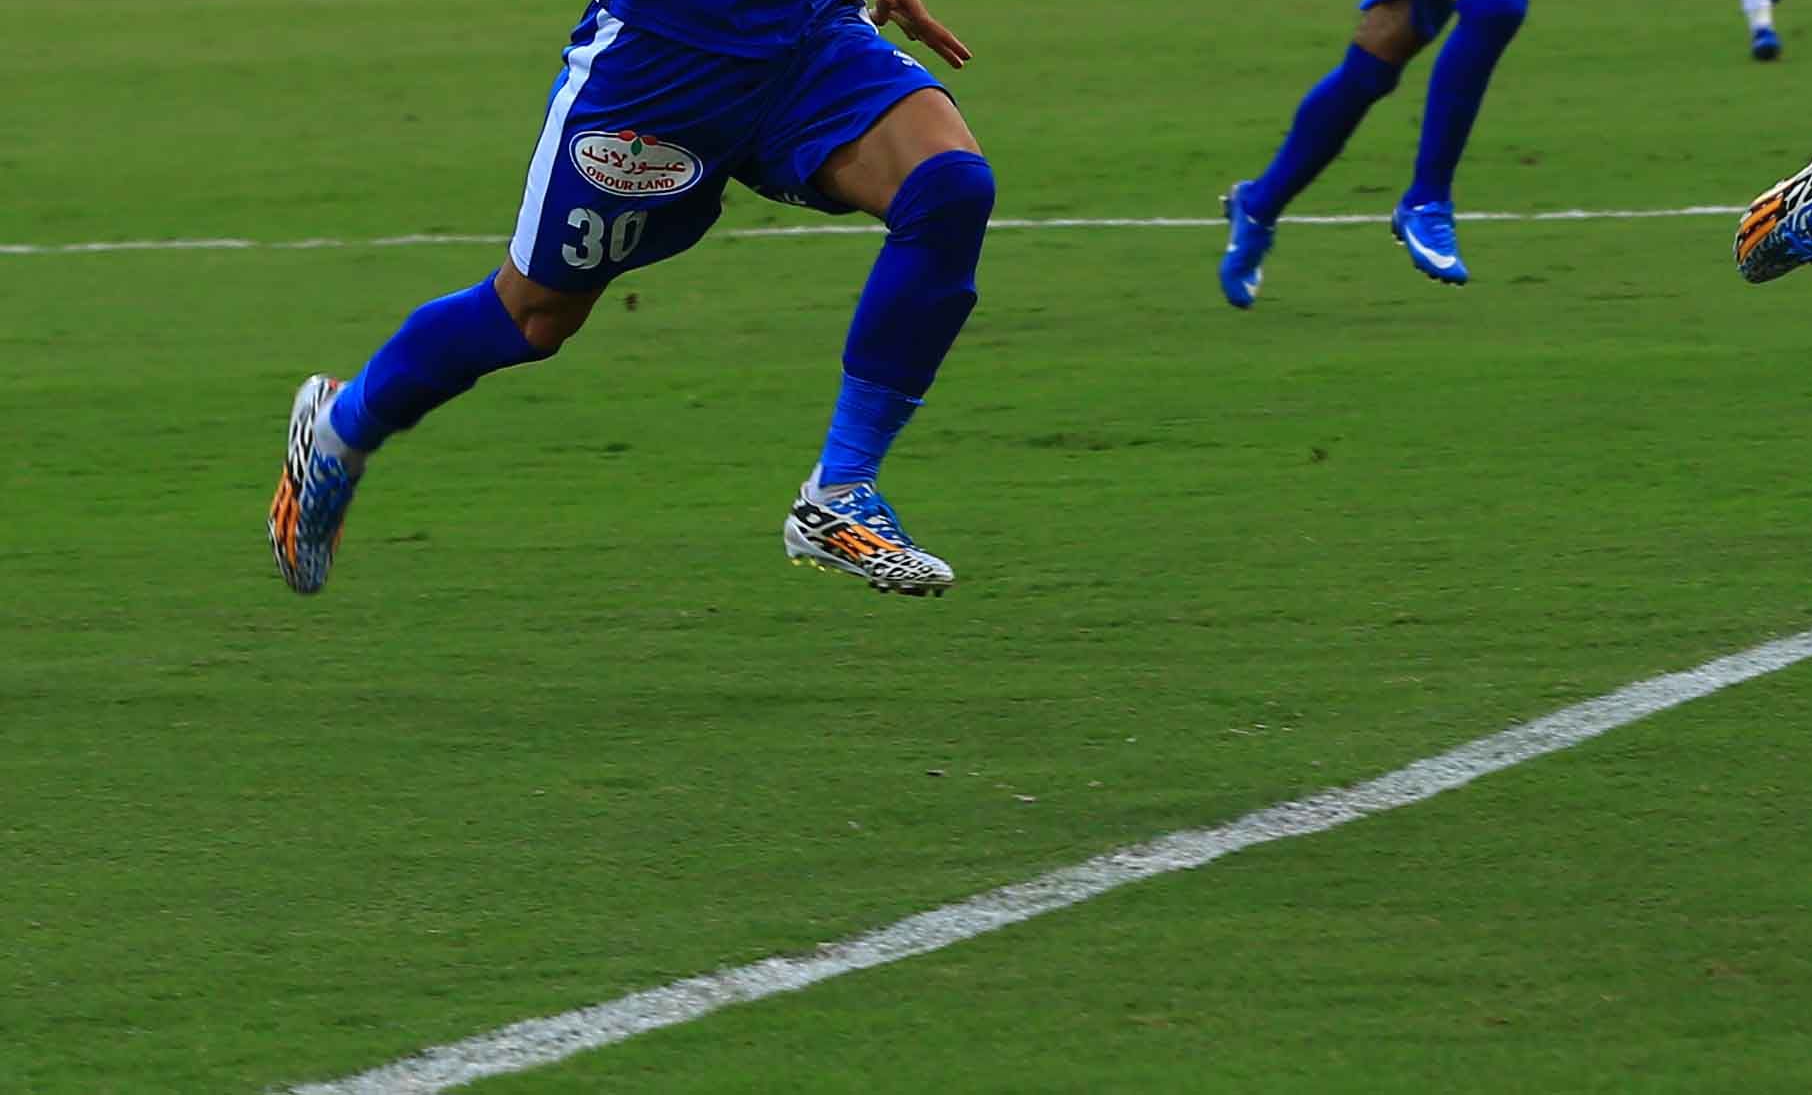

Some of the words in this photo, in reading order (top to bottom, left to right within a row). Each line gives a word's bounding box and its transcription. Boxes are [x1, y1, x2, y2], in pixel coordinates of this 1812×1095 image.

[582, 145, 687, 177] عبورلاند
[586, 165, 634, 191] OBOUR
[638, 177, 676, 191] LAND
[561, 207, 648, 270] 30
